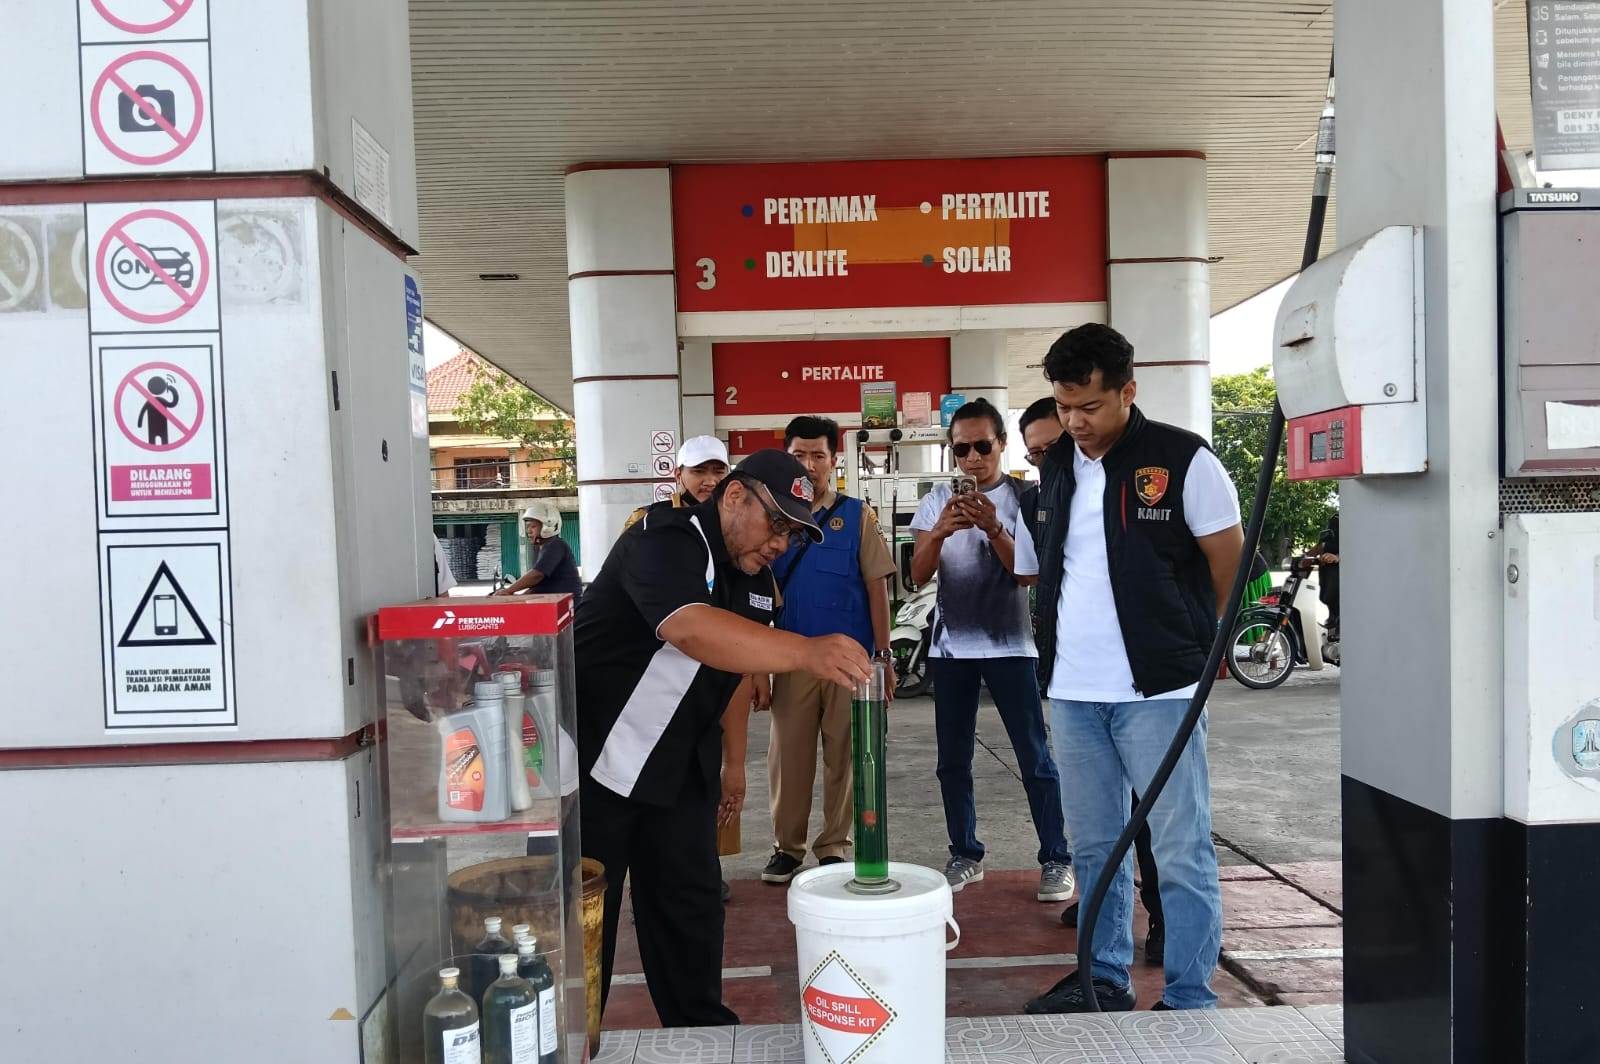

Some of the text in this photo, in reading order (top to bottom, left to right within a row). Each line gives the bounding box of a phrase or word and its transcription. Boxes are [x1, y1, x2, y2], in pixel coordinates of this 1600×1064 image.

[1529, 192, 1579, 203] TATSUNO
[764, 194, 878, 225] PERTAMAX
[941, 190, 1051, 221] PERTALITE
[117, 259, 150, 274] ON
[766, 250, 848, 278] DEXLITE
[942, 245, 1012, 274] SOLAR
[695, 257, 717, 291] 3
[801, 364, 884, 382] PERTALITE
[724, 385, 738, 406] 2
[736, 434, 743, 450] 1
[130, 467, 192, 482] DILARANG
[130, 480, 182, 489] MENGGUNAKAN
[130, 489, 152, 497] UNTUK
[1137, 507, 1171, 521] KANIT
[458, 616, 505, 625] PERTAMINA
[149, 668, 170, 676] UNTUK
[171, 667, 211, 675] MELAKUKAN
[126, 675, 211, 684] TRANSAKSI PEMBAYARAN
[126, 682, 212, 693] PADA JARAK AMAN
[815, 996, 861, 1015] OIL SPILL
[808, 1004, 877, 1028] RESPONSE KIT
